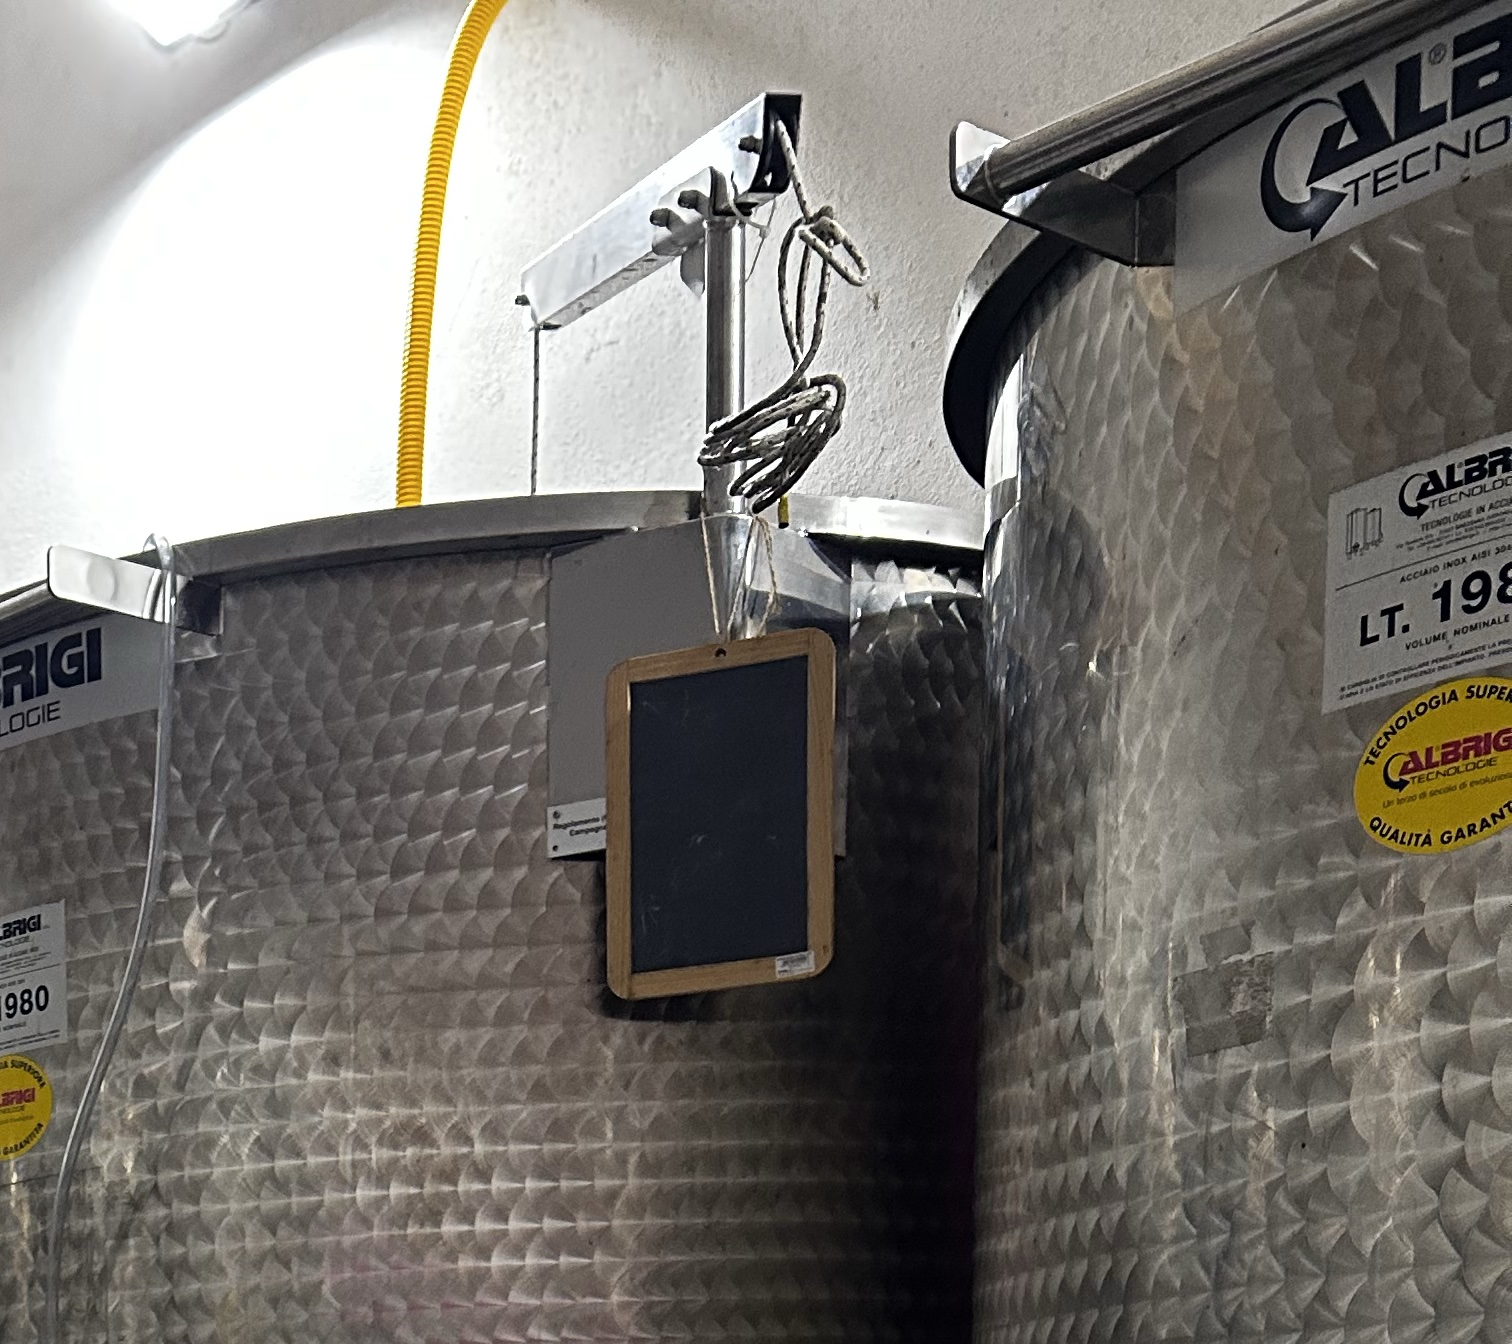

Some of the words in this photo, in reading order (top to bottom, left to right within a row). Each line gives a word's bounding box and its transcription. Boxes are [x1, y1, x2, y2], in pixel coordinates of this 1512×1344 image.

[1399, 565, 1440, 583] ACCIAIO
[1443, 557, 1467, 570] INOX
[1360, 603, 1410, 647] LT.
[1405, 632, 1448, 650] VOLUME
[1453, 614, 1510, 636] NOMINALE
[1364, 689, 1459, 767] TECNOLOGIA
[1409, 756, 1499, 785] TECNOLOGIE
